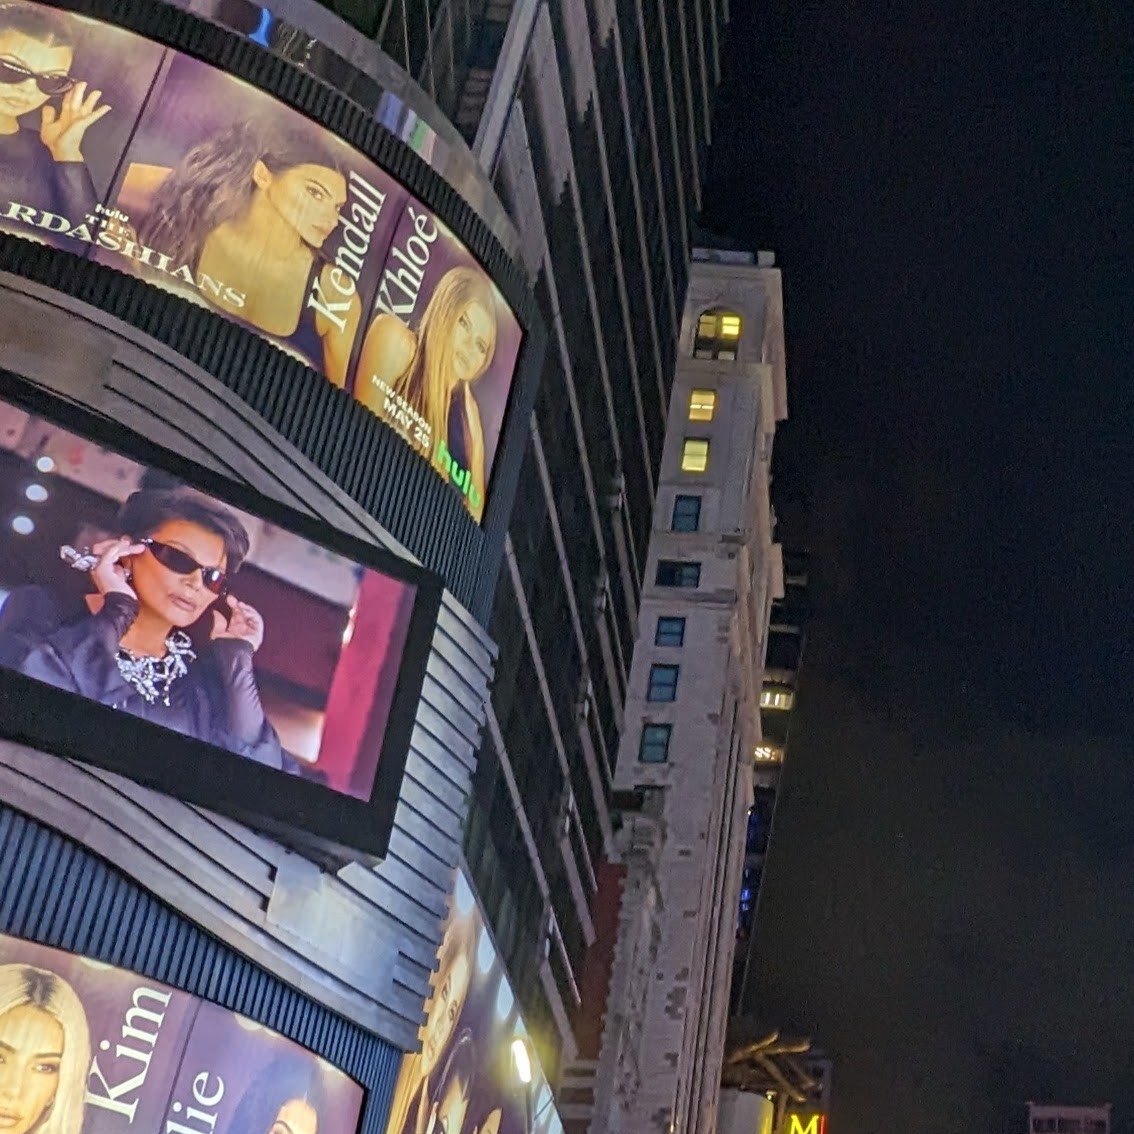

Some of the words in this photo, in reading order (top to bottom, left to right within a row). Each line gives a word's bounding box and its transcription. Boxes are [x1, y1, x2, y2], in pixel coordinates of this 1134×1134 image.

[0, 201, 246, 308] RDASHIANS
[95, 203, 129, 222] hulu
[307, 170, 387, 334] Kendall
[374, 206, 438, 327] Khloé
[372, 375, 395, 398] NEW
[396, 395, 431, 434] SEASON
[384, 398, 413, 430] MAY
[413, 426, 430, 448] 25
[437, 440, 480, 508] hulu
[85, 987, 172, 1124] Kim
